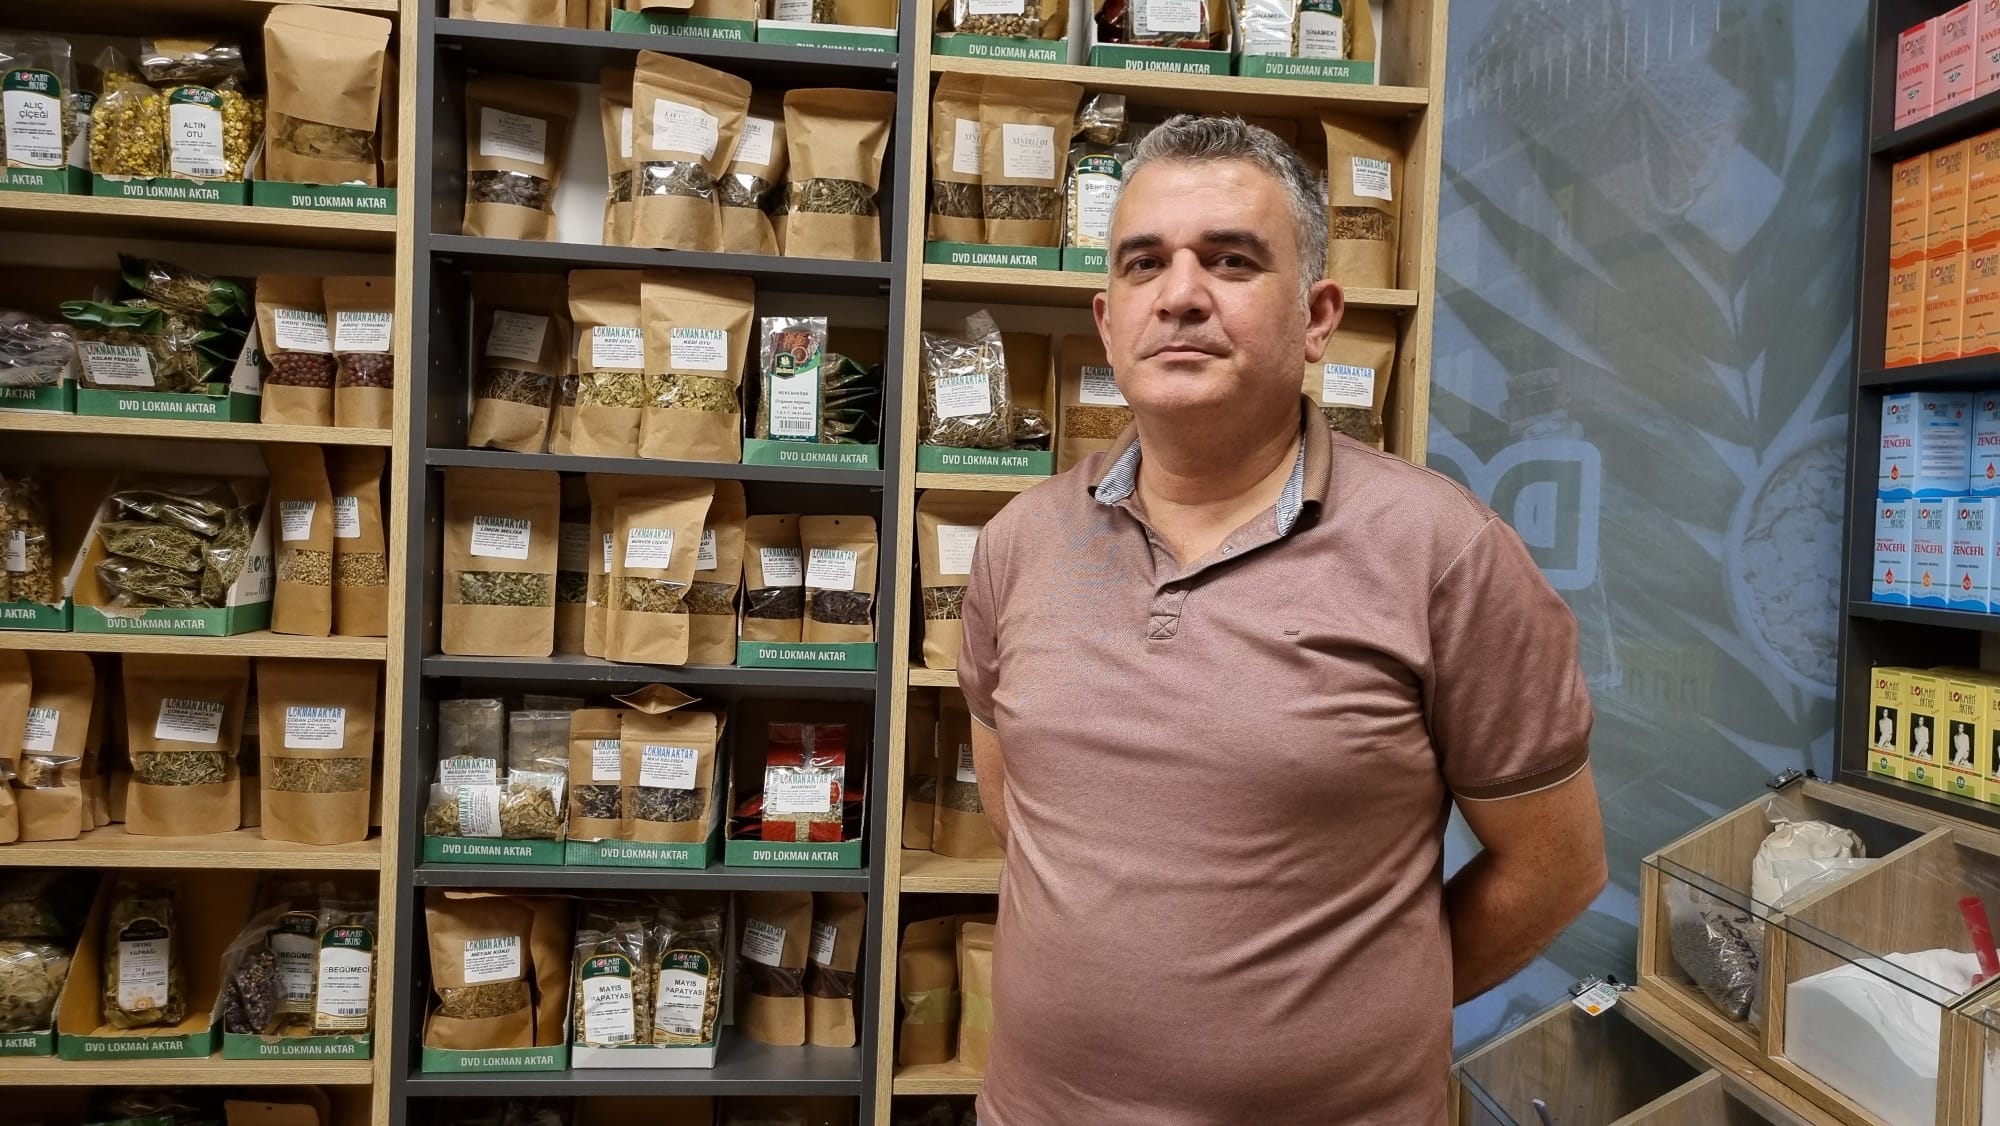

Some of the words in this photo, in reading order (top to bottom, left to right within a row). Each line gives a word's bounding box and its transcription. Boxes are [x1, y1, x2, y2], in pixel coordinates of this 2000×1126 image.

[650, 24, 668, 35] DVD
[672, 26, 710, 38] LOKMAN
[712, 28, 741, 40] AKTAR
[969, 45, 987, 55] DVD
[990, 46, 1026, 58] LOKMAN
[1028, 49, 1056, 60] AKTAR
[1126, 60, 1143, 70] DVD
[1146, 61, 1181, 73] LOKMAN
[1183, 64, 1210, 74] AKTAR
[1266, 64, 1282, 74] DVD
[1286, 64, 1320, 75] LOKMAN
[1322, 66, 1349, 77] AKTAR
[24, 102, 44, 110] ALIÇ
[19, 110, 48, 119] ÇİÇEĞİ
[184, 122, 206, 130] ALTIN
[12, 176, 43, 186] AKTAR
[124, 184, 143, 196] DVD
[146, 186, 187, 198] LOKMAN
[189, 188, 220, 200] AKTAR
[292, 196, 310, 206] DVD
[314, 196, 353, 208] LOKMAN
[355, 198, 386, 209] AKTAR
[952, 253, 970, 263] DVD
[972, 254, 1008, 264] LOKMAN
[1010, 255, 1037, 265] AKTAR
[1084, 256, 1102, 264] DVD
[7, 390, 36, 400] AKTAR
[120, 400, 139, 410] DVD
[142, 400, 182, 412] LOKMAN
[186, 403, 216, 413] AKTAR
[1883, 437, 1911, 448] ZENCEFİL
[780, 451, 797, 461] DVD
[801, 452, 838, 462] LOKMAN
[840, 453, 868, 463] AKTAR
[942, 455, 960, 464] DVD
[962, 456, 998, 465] LOKMAN
[1001, 457, 1028, 466] AKTAR
[1876, 541, 1906, 552] ZENCEFİL
[1914, 543, 1943, 554] ZENCEFİL
[1953, 544, 1984, 556] ZENCEFİL
[4, 609, 36, 619] AKTAR
[107, 618, 126, 628] DVD
[130, 619, 171, 629] LOKMAN
[174, 620, 204, 629] AKTAR
[759, 649, 777, 659] DVD
[780, 650, 815, 660] LOKMAN
[818, 652, 846, 661] AKTAR
[442, 844, 461, 853] DVD
[464, 845, 500, 855] LOKMAN
[503, 847, 532, 856] AKTAR
[601, 848, 619, 857] DVD
[622, 849, 658, 859] LOKMAN
[660, 850, 688, 860] AKTAR
[753, 850, 770, 860] DVD
[774, 851, 809, 860] LOKMAN
[812, 852, 839, 861] AKTAR
[674, 979, 696, 987] MAYIS
[5, 1038, 36, 1047] AKTAR
[85, 1042, 105, 1052] DVD
[108, 1042, 149, 1052] LOKMAN
[152, 1041, 183, 1050] AKTAR
[260, 1045, 279, 1054] DVD
[282, 1045, 321, 1054] LOKMAN
[324, 1044, 355, 1054] AKTAR
[461, 1057, 480, 1066] DVD
[483, 1057, 521, 1066] LOKMAN
[524, 1056, 554, 1065] AKTAR
